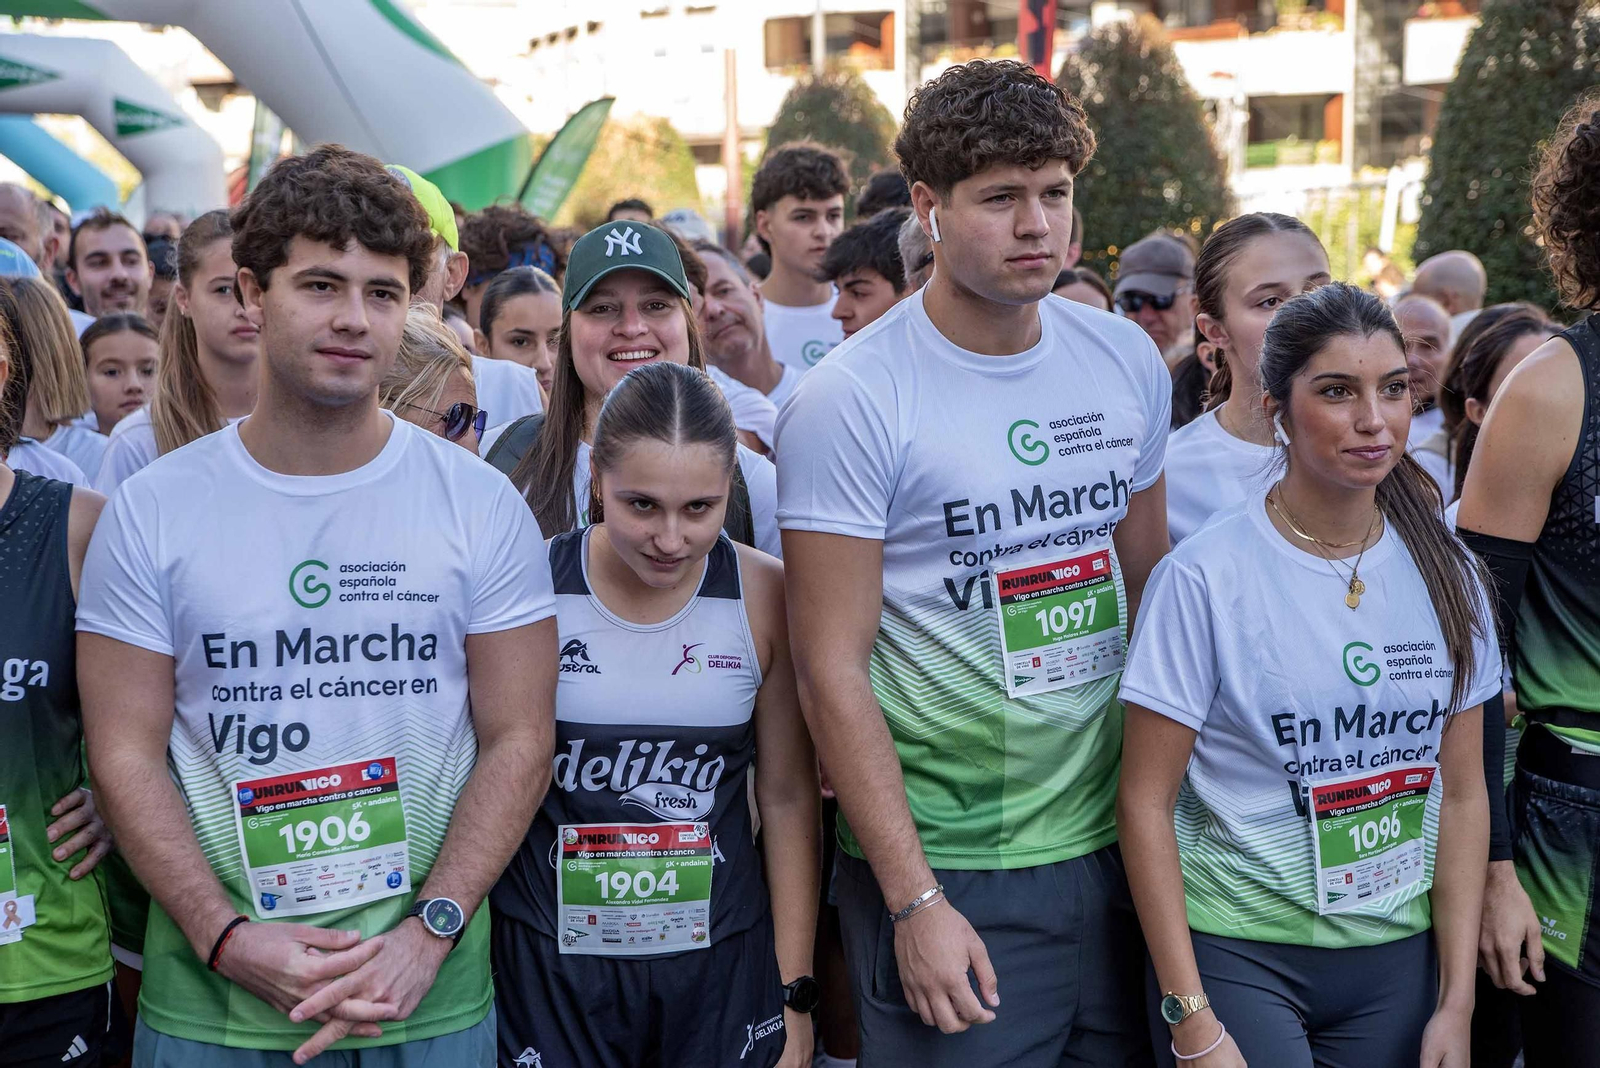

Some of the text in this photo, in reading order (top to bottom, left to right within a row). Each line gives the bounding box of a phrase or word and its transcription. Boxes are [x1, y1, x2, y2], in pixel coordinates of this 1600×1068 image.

[604, 226, 643, 257] NY
[1049, 412, 1105, 430] asociación
[1054, 426, 1102, 444] española
[1058, 435, 1134, 457] contra el cáncer
[943, 499, 1001, 537] En
[950, 544, 1023, 567] contra
[1028, 533, 1050, 549] el
[340, 562, 406, 573] asociación
[340, 575, 396, 589] española
[943, 570, 994, 610] Vi
[1014, 594, 1030, 602] Vigo
[1041, 585, 1064, 596] marcha
[1065, 582, 1083, 591] contra
[1089, 576, 1105, 585] cancro
[340, 590, 439, 603] contra el cáncer
[1036, 597, 1096, 636] 1097
[202, 623, 437, 668] En Marcha
[1383, 641, 1436, 653] asociación
[709, 661, 741, 669] DELIKIA
[1387, 654, 1432, 668] española
[1389, 670, 1422, 681] contra
[1425, 668, 1432, 678] el
[212, 676, 437, 702] contra el cáncer en
[1271, 699, 1447, 747] En March
[208, 712, 310, 765] Vigo
[1284, 754, 1342, 776] cntra
[1345, 750, 1364, 769] el
[1370, 745, 1432, 767] cáncer
[253, 774, 342, 799] UNRUNVIGO
[256, 805, 274, 813] Vigo
[287, 798, 317, 808] marcha
[319, 793, 346, 802] contra
[355, 787, 381, 796] cancro
[352, 802, 362, 810] 5K
[368, 796, 397, 806] andaina
[655, 792, 697, 808] fresh
[1330, 809, 1345, 817] Vigo
[1356, 802, 1378, 812] marcha
[1396, 790, 1416, 798] cancro
[279, 812, 370, 854] 1906
[576, 833, 660, 844] UNRUNVIGO
[1349, 810, 1400, 852] 1096
[596, 870, 679, 898] 1904
[755, 1020, 784, 1040] DELIKIA
